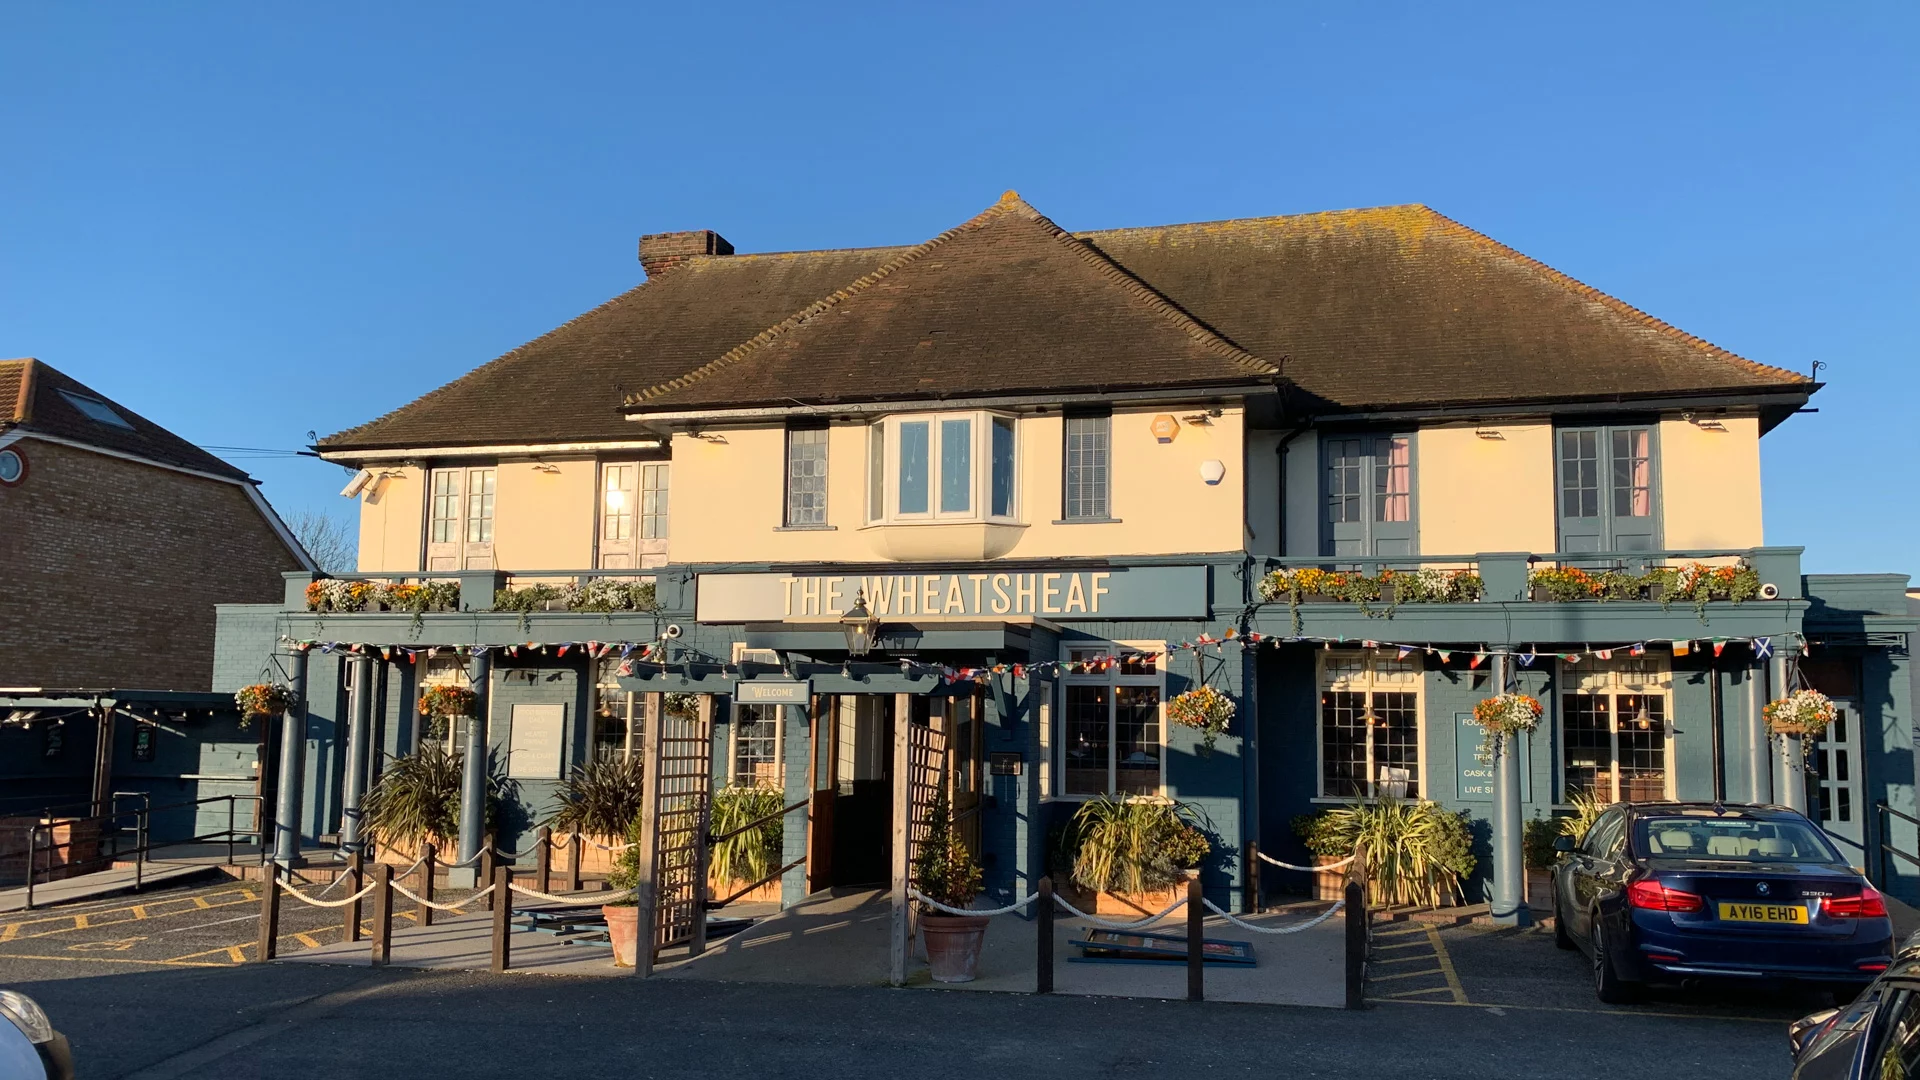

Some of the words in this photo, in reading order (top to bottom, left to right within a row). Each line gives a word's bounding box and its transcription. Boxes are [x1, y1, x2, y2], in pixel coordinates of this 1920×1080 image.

[779, 577, 845, 616] THE
[861, 572, 1111, 615] WHEATSHEAF
[752, 686, 793, 698] WELCOME
[1463, 769, 1486, 777] CASK
[1464, 786, 1482, 794] LIVE
[1729, 905, 1763, 919] AY16
[1767, 906, 1798, 921] EHD
